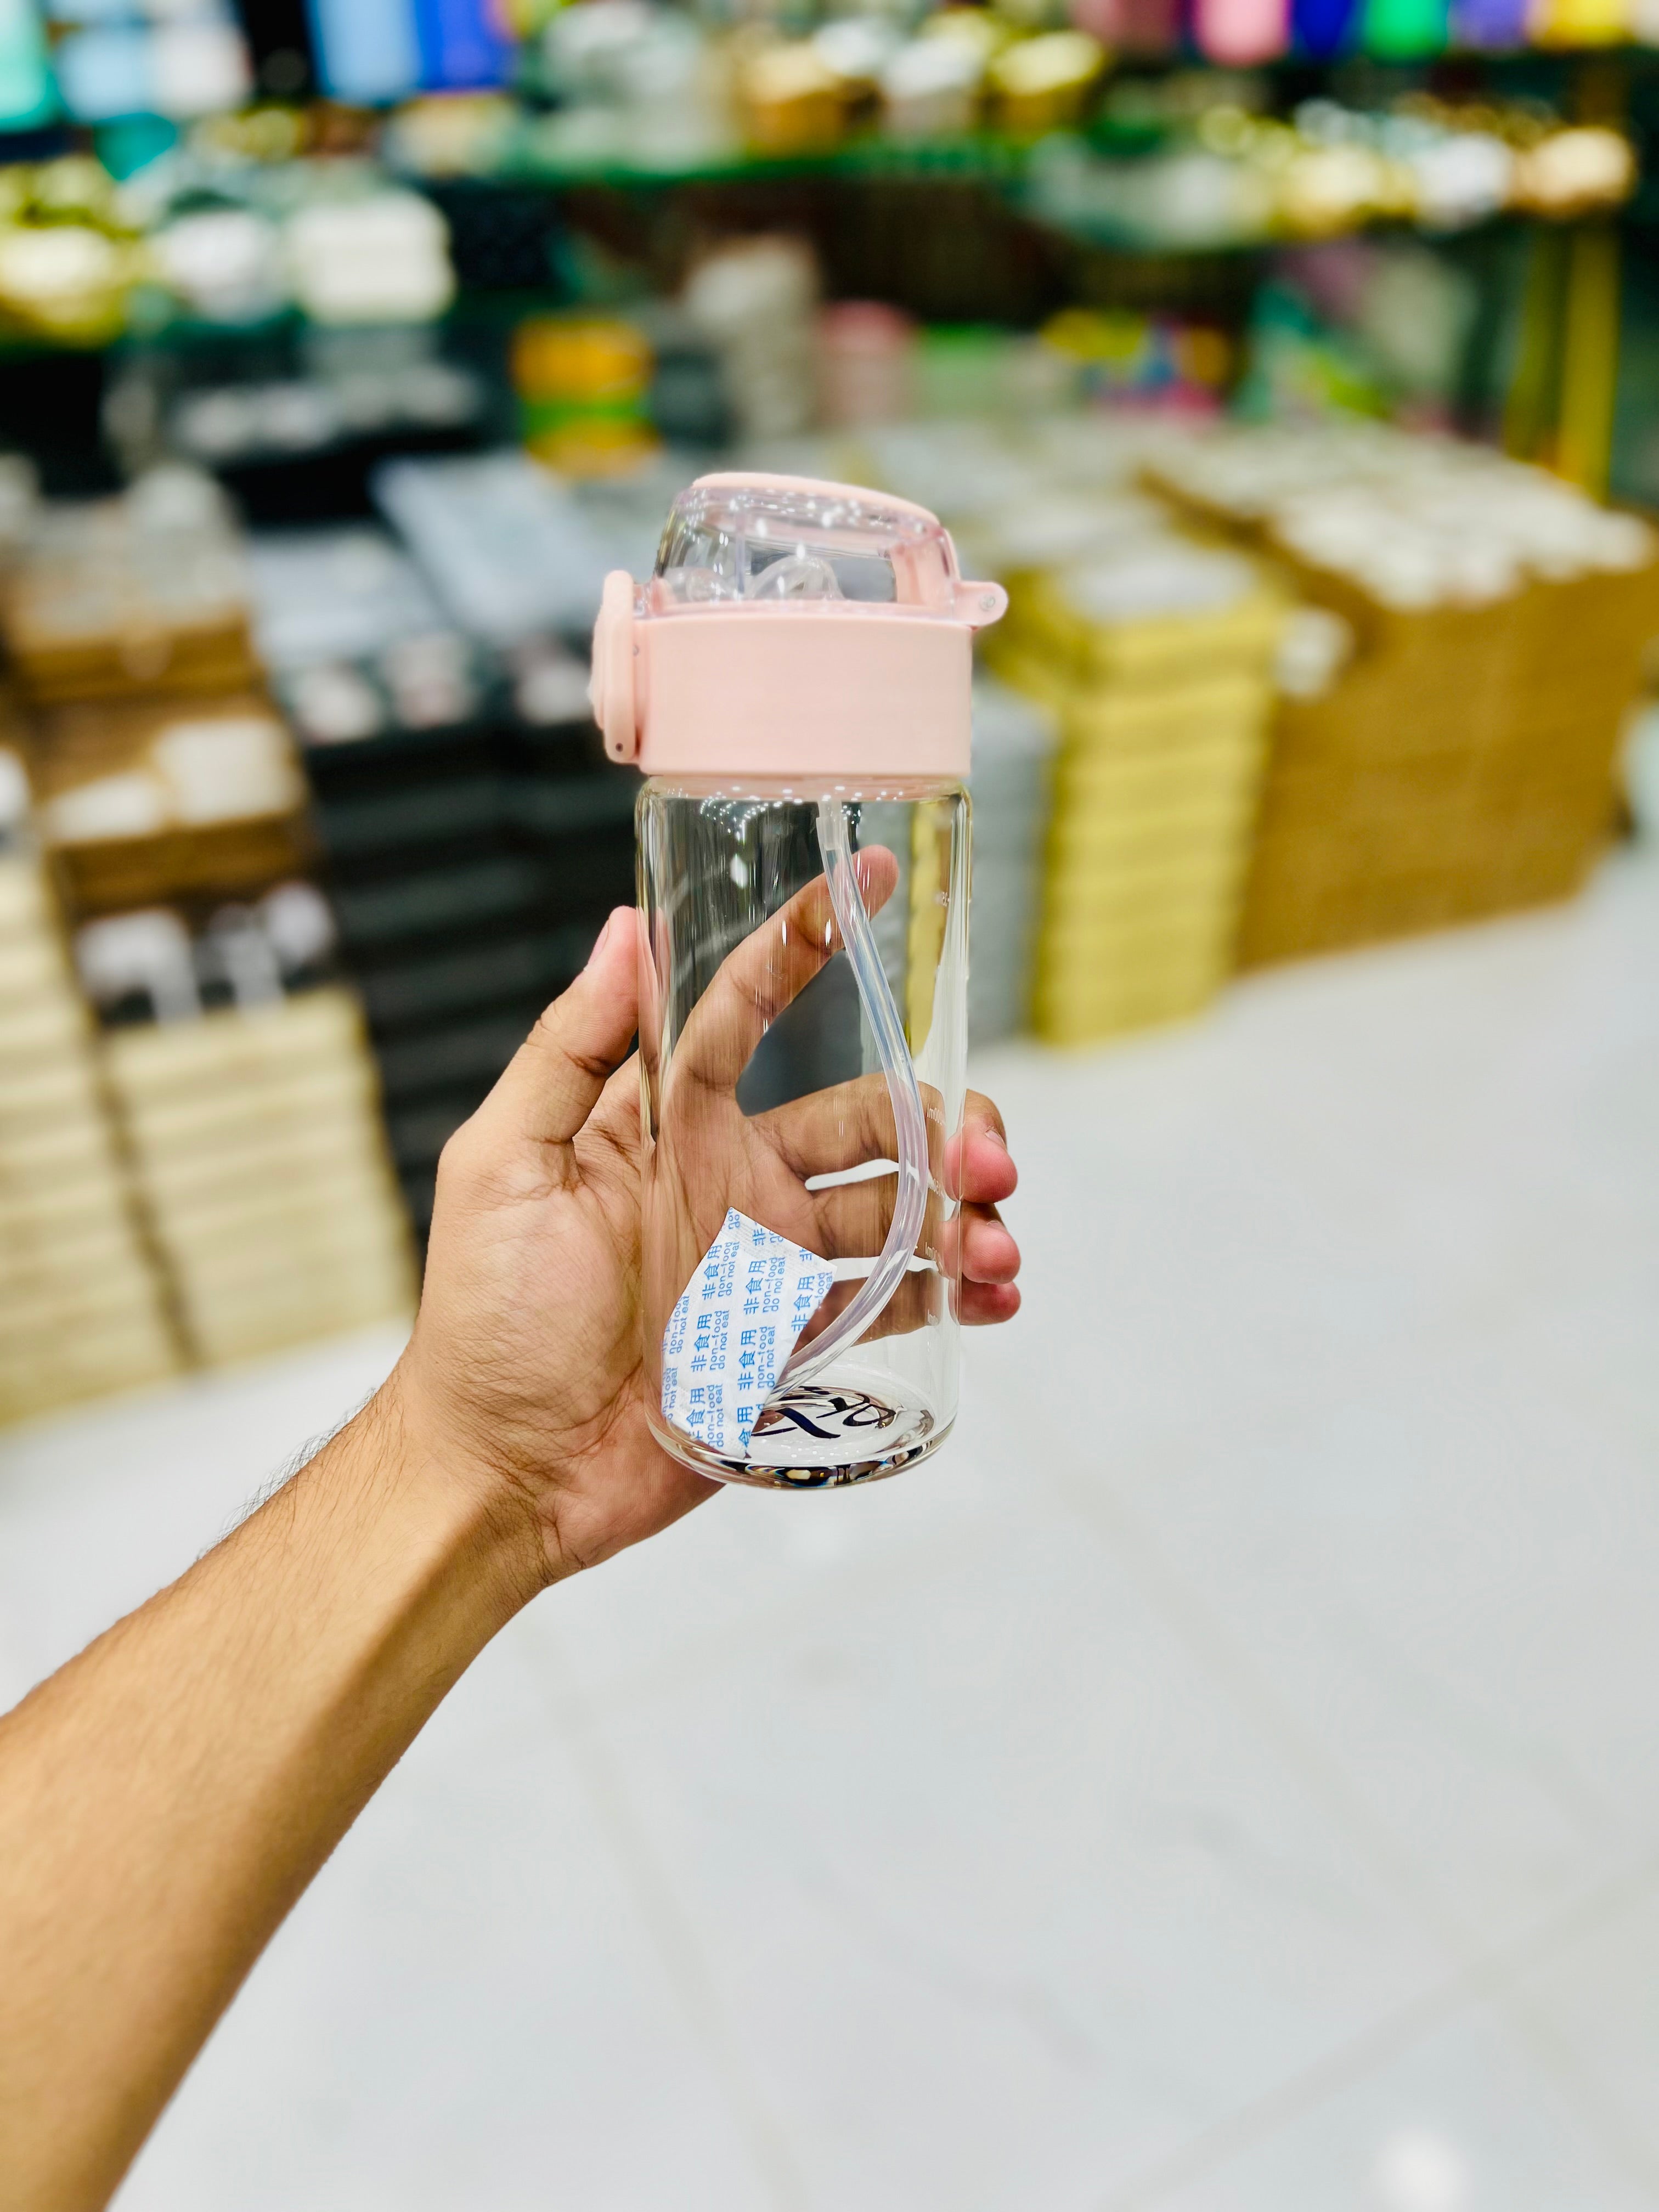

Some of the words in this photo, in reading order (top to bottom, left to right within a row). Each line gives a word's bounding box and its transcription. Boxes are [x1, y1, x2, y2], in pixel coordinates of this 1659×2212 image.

[702, 1244, 722, 1300] 非食用
[718, 1242, 733, 1297] non-food
[725, 1282, 733, 1295] do
[731, 1241, 740, 1257] eat
[743, 1260, 767, 1315] 非食用
[763, 1257, 777, 1313] non-food
[774, 1278, 783, 1294] not
[777, 1257, 785, 1274] eat
[815, 1272, 825, 1305] -food
[771, 1298, 780, 1312] do
[791, 1276, 815, 1331] 非食用
[676, 1339, 683, 1353] do
[691, 1313, 712, 1372] 非食用
[710, 1310, 722, 1370] non-food
[718, 1355, 725, 1369] do
[737, 1330, 757, 1391] 非食用
[758, 1327, 767, 1389] non-food
[767, 1373, 775, 1387] do
[707, 1385, 715, 1447] non-food
[716, 1432, 724, 1447] do
[737, 1407, 753, 1448] 食用
